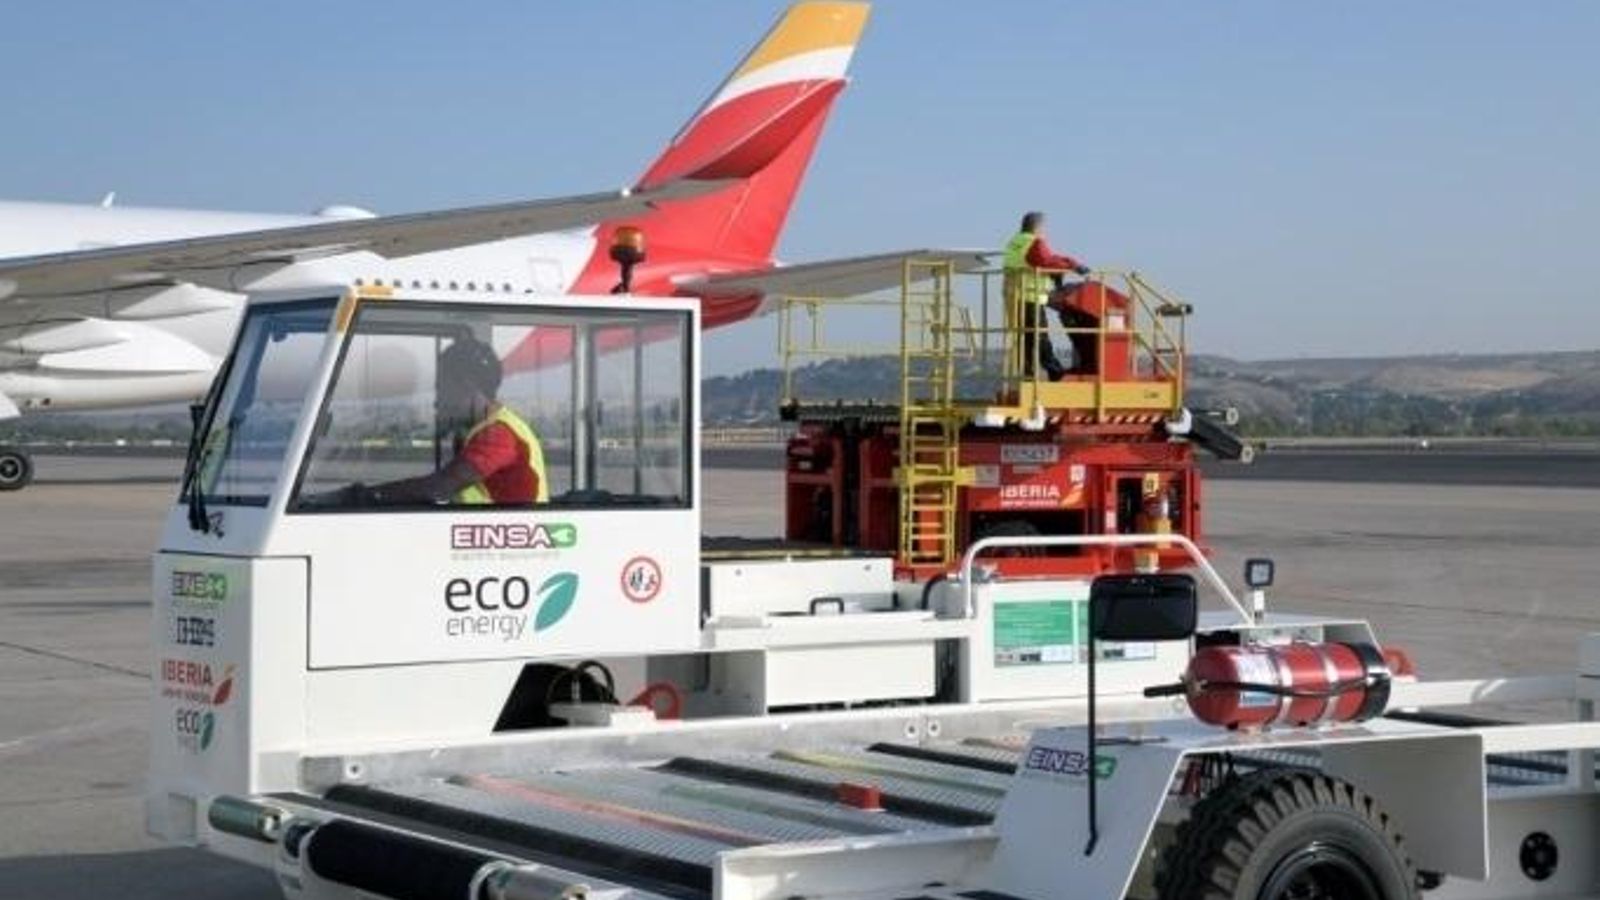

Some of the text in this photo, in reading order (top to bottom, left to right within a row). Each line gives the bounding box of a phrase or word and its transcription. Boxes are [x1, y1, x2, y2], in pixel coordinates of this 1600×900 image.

[1000, 484, 1061, 499] IBERIA
[451, 525, 556, 549] EINSA
[445, 576, 530, 612] eco
[447, 614, 527, 641] energy
[161, 660, 213, 686] IBERIA
